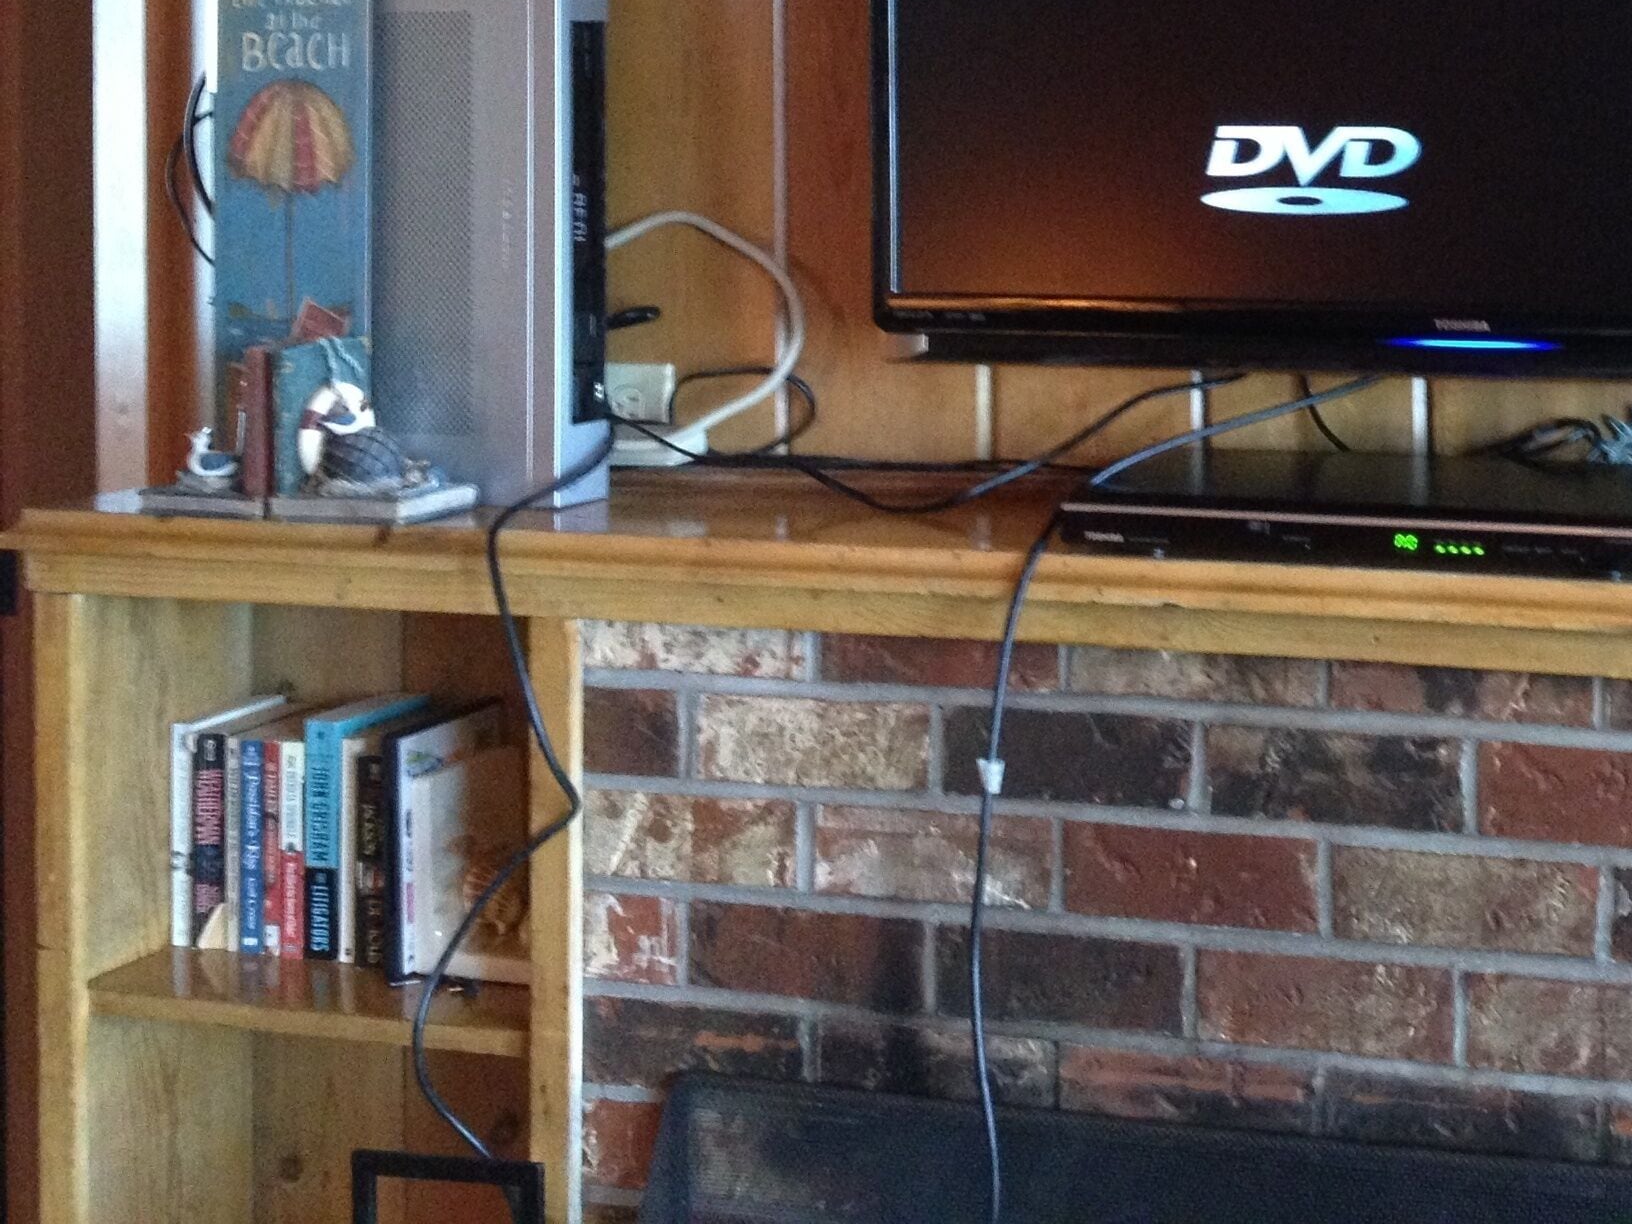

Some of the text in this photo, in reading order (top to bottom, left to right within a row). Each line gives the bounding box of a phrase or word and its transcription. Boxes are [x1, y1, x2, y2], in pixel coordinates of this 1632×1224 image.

[1205, 125, 1422, 187] DVD
[310, 767, 330, 863] JOHN GRISHAM
[310, 885, 330, 953] LITIGATORS
